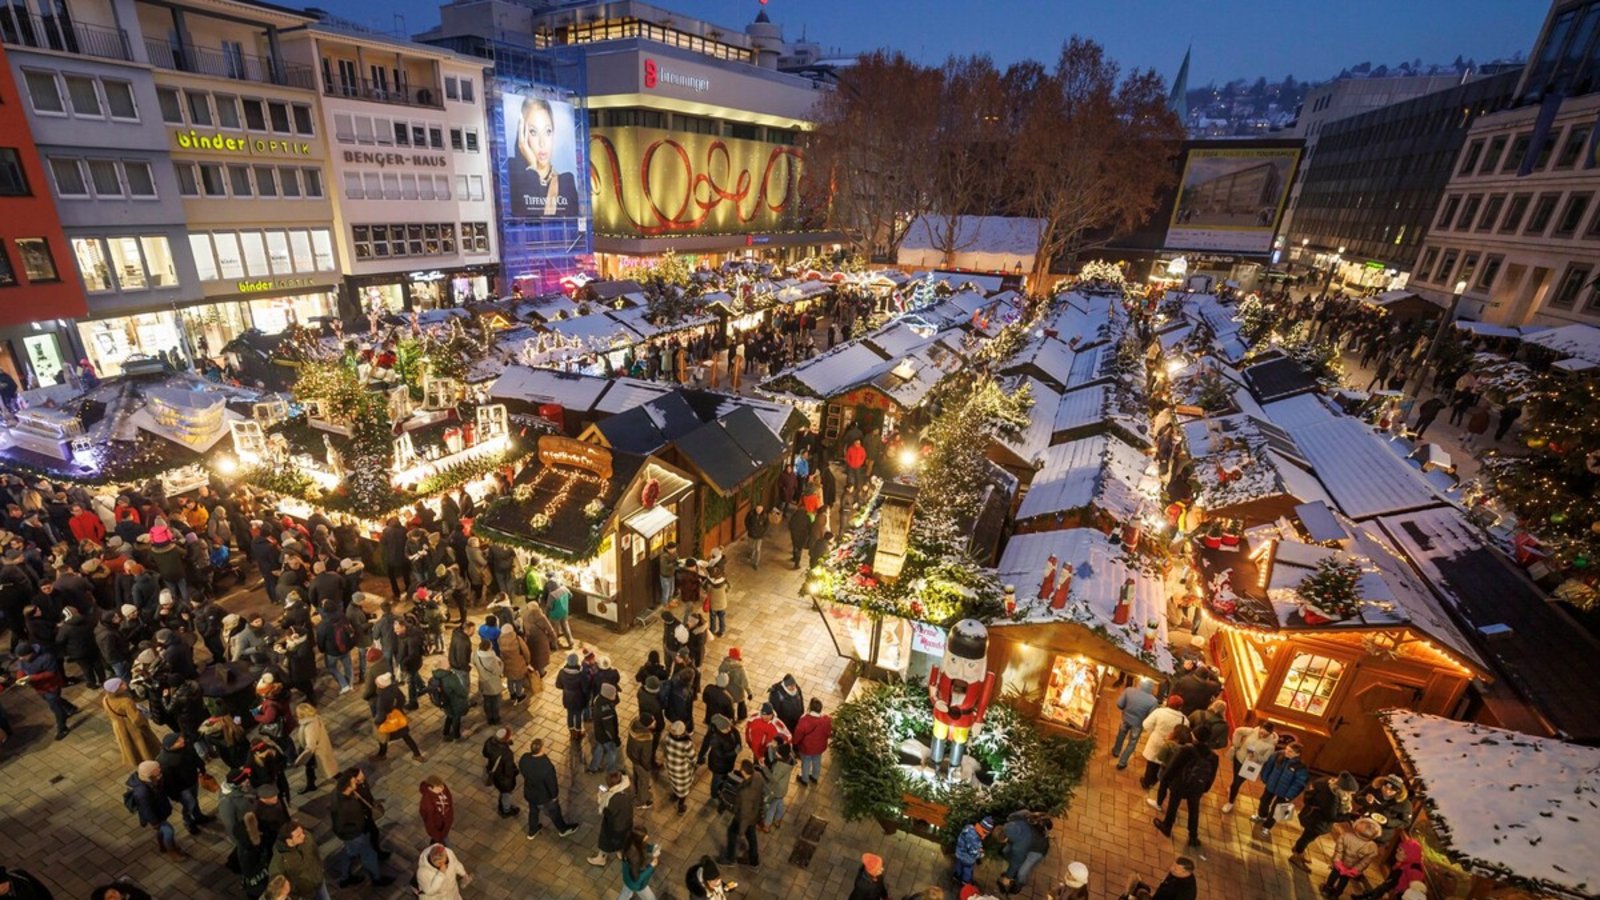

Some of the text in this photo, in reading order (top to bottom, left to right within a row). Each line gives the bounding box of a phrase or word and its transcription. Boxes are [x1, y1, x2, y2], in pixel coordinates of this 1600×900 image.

[176, 129, 311, 155] binder OPTIK
[343, 150, 447, 168] BENGER-HAUS
[238, 281, 273, 293] binder
